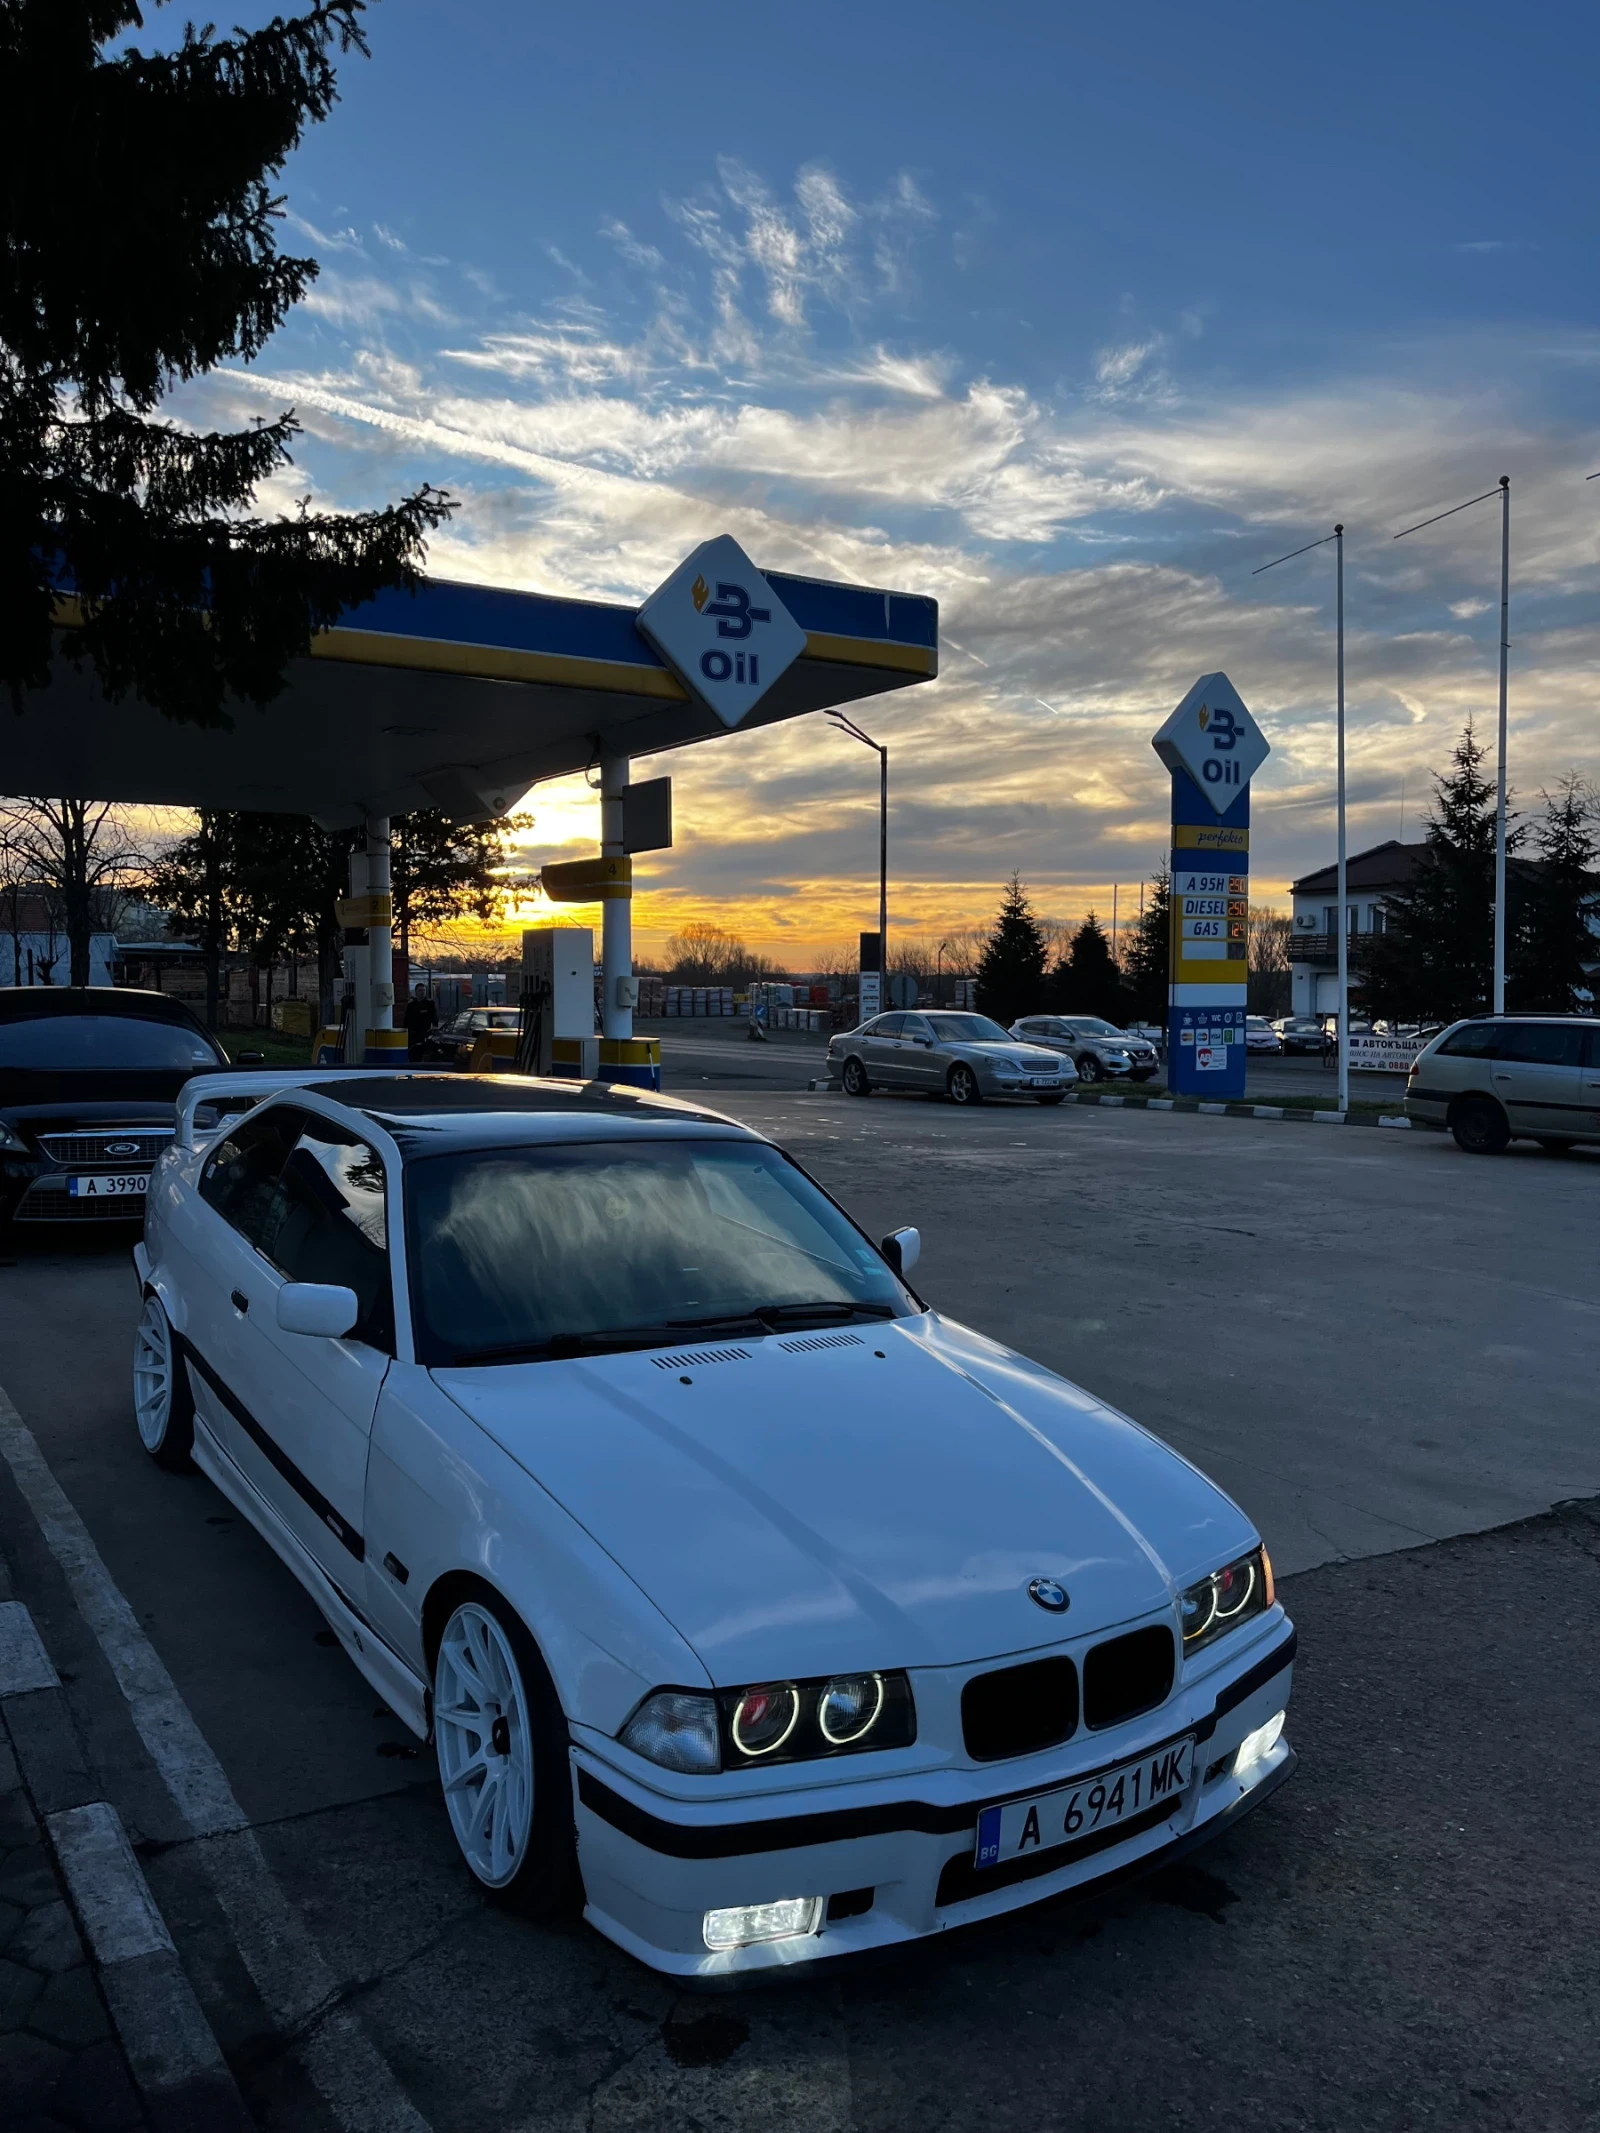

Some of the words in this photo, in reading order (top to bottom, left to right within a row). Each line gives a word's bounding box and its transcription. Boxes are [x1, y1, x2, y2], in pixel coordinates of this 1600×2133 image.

[608, 863, 617, 875] 4
[1187, 877, 1196, 891] A
[1185, 900, 1225, 915] DIESEL
[1194, 922, 1219, 936] GAS
[1211, 1014, 1221, 1022] WC
[1362, 1039, 1418, 1051] АВТОКЪЩА
[87, 1179, 97, 1194] A
[106, 1177, 147, 1193] 3990
[1018, 1805, 1041, 1850] A
[980, 1844, 998, 1861] BG
